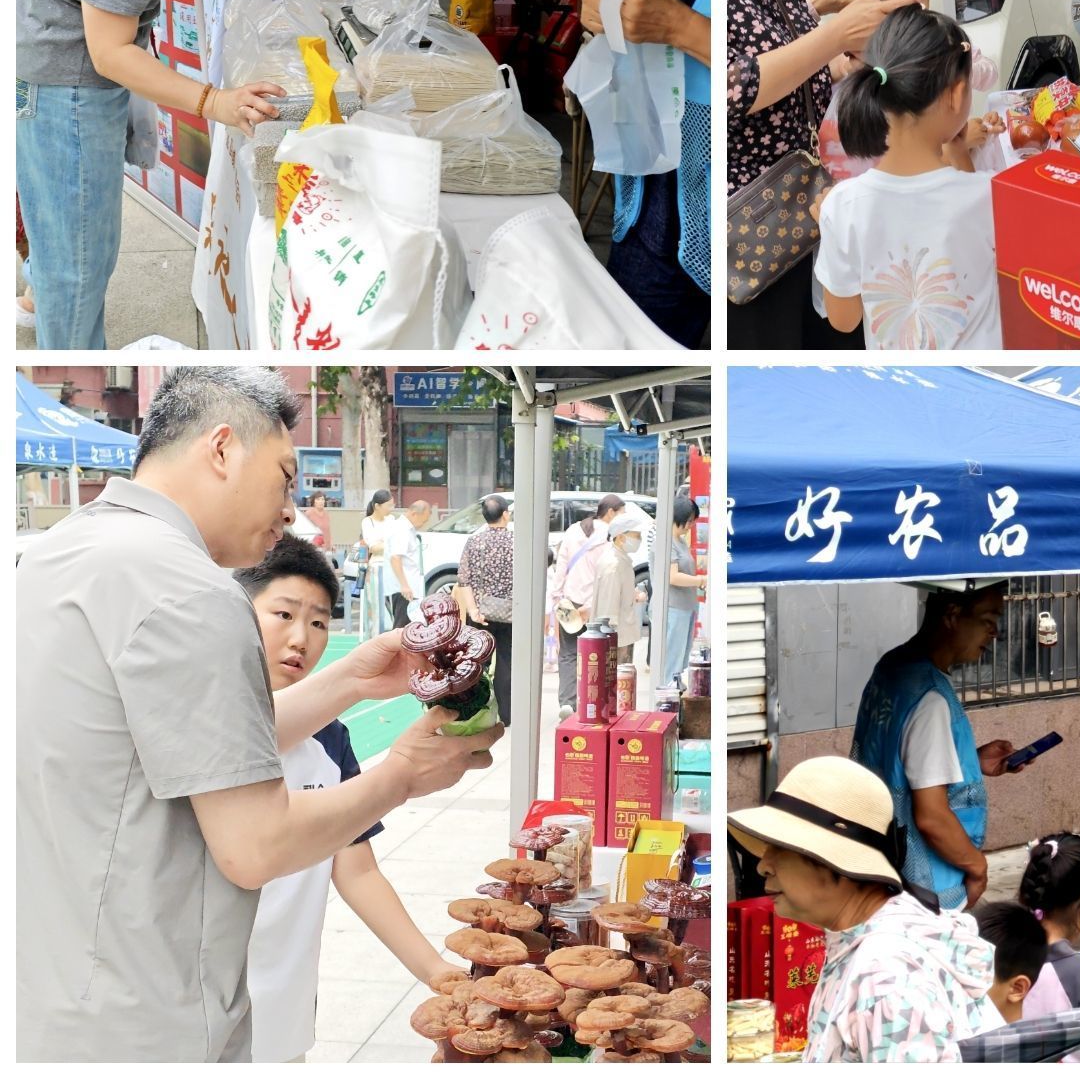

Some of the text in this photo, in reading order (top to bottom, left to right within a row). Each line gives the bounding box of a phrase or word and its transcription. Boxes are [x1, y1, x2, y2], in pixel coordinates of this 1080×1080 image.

[24, 440, 58, 462] 泉水造
[784, 484, 1028, 563] 好农品
